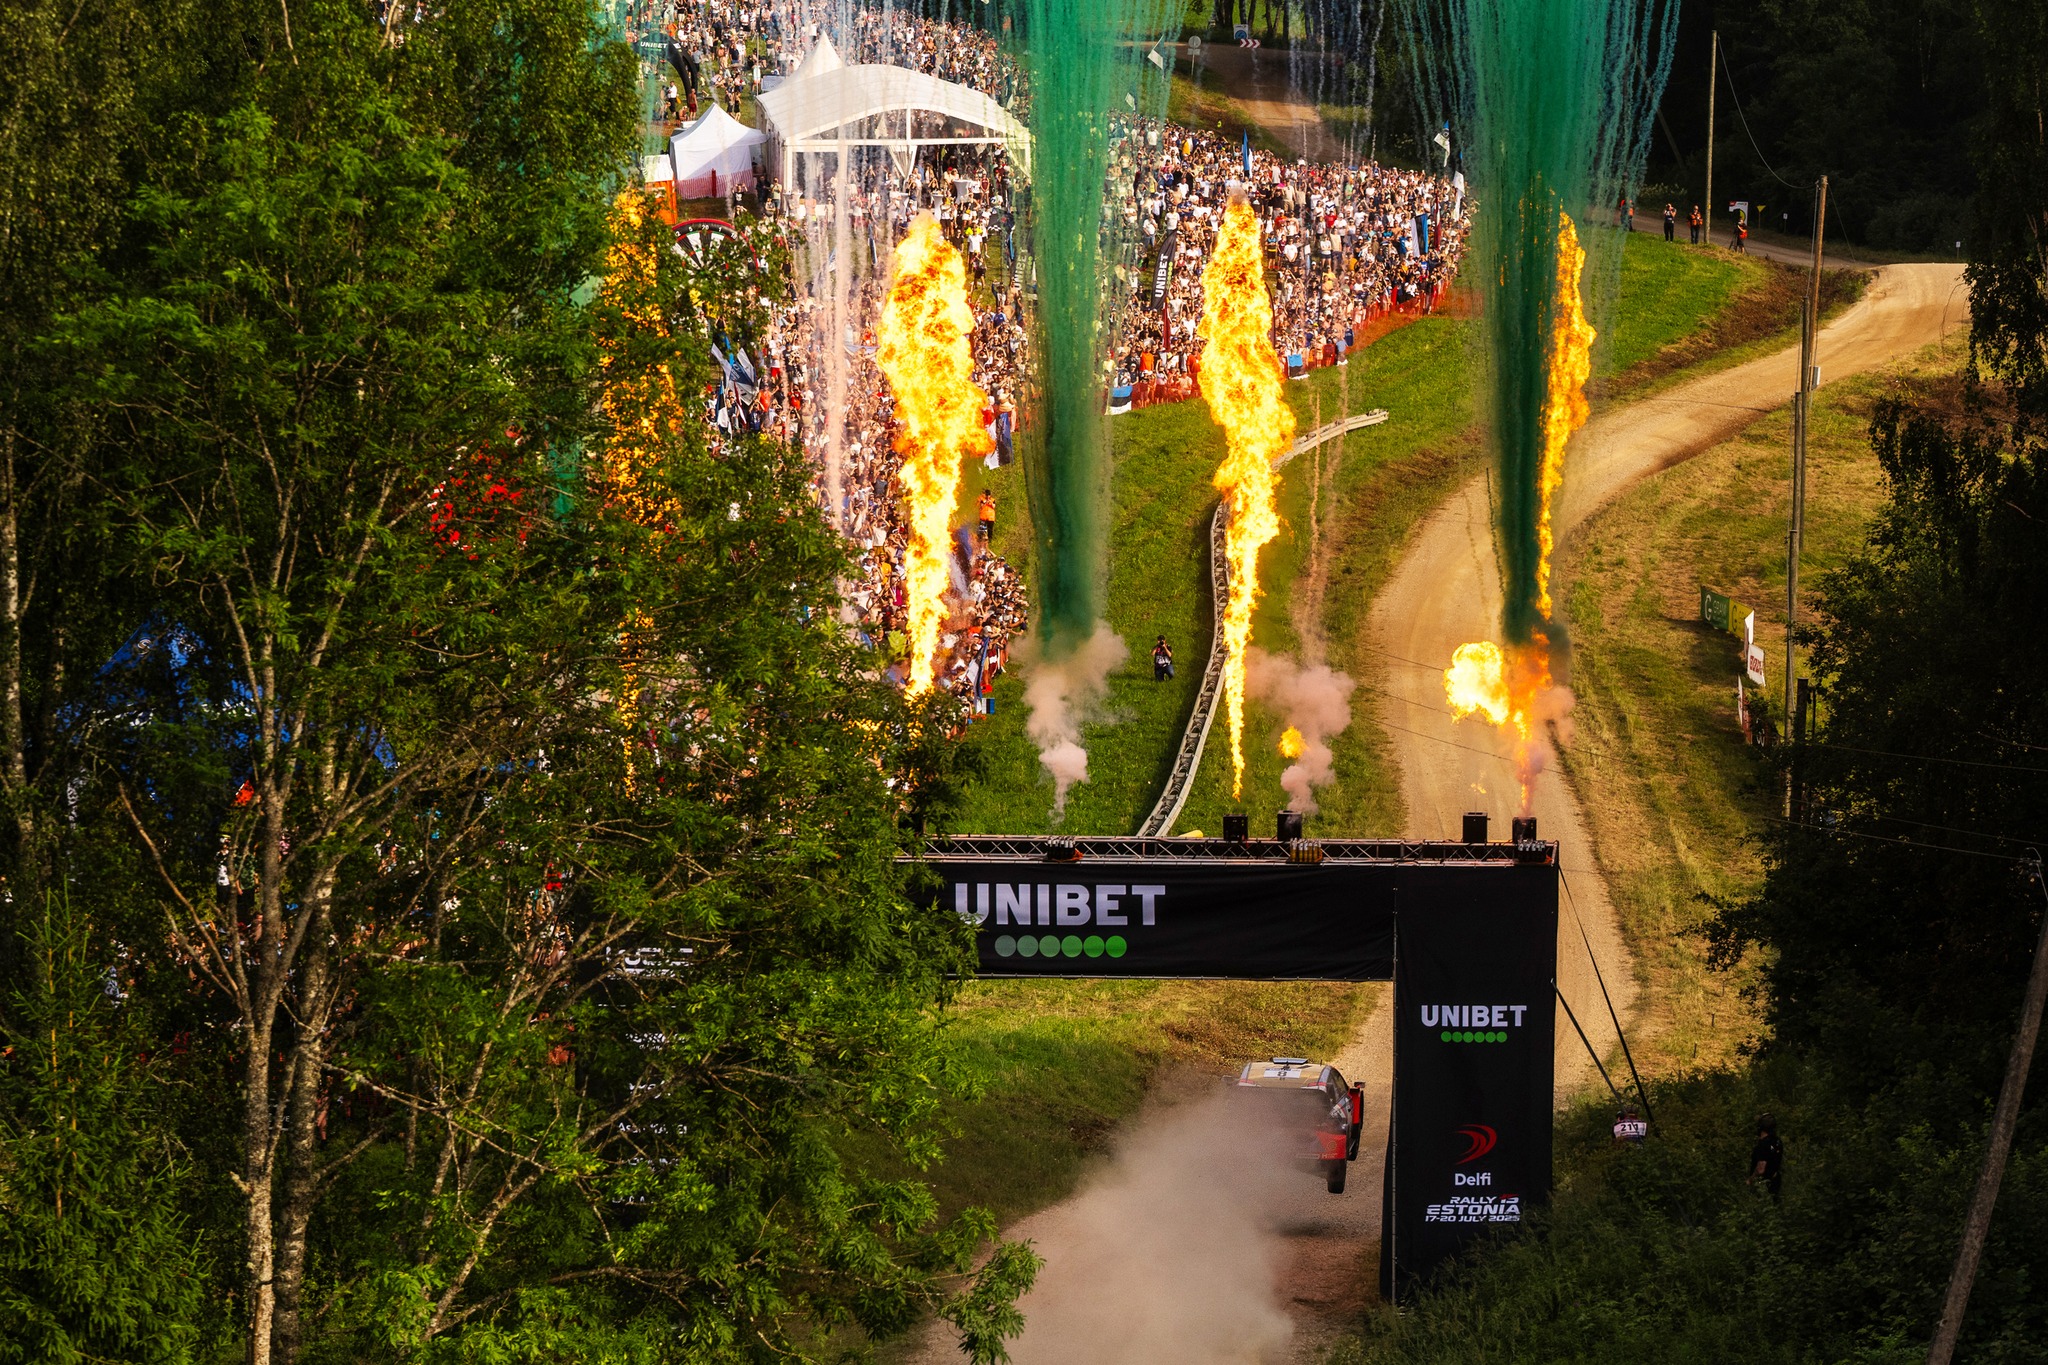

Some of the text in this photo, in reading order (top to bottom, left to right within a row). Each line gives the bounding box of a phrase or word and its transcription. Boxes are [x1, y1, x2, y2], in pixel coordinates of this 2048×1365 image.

[640, 41, 668, 49] UNIBET
[1155, 253, 1169, 298] UNIBET
[955, 883, 1166, 926] UNIBET
[1421, 1005, 1527, 1027] UNIBET
[1454, 1172, 1492, 1186] Delfi
[1450, 1196, 1497, 1204] RALLY
[1426, 1205, 1521, 1215] ESTONIA
